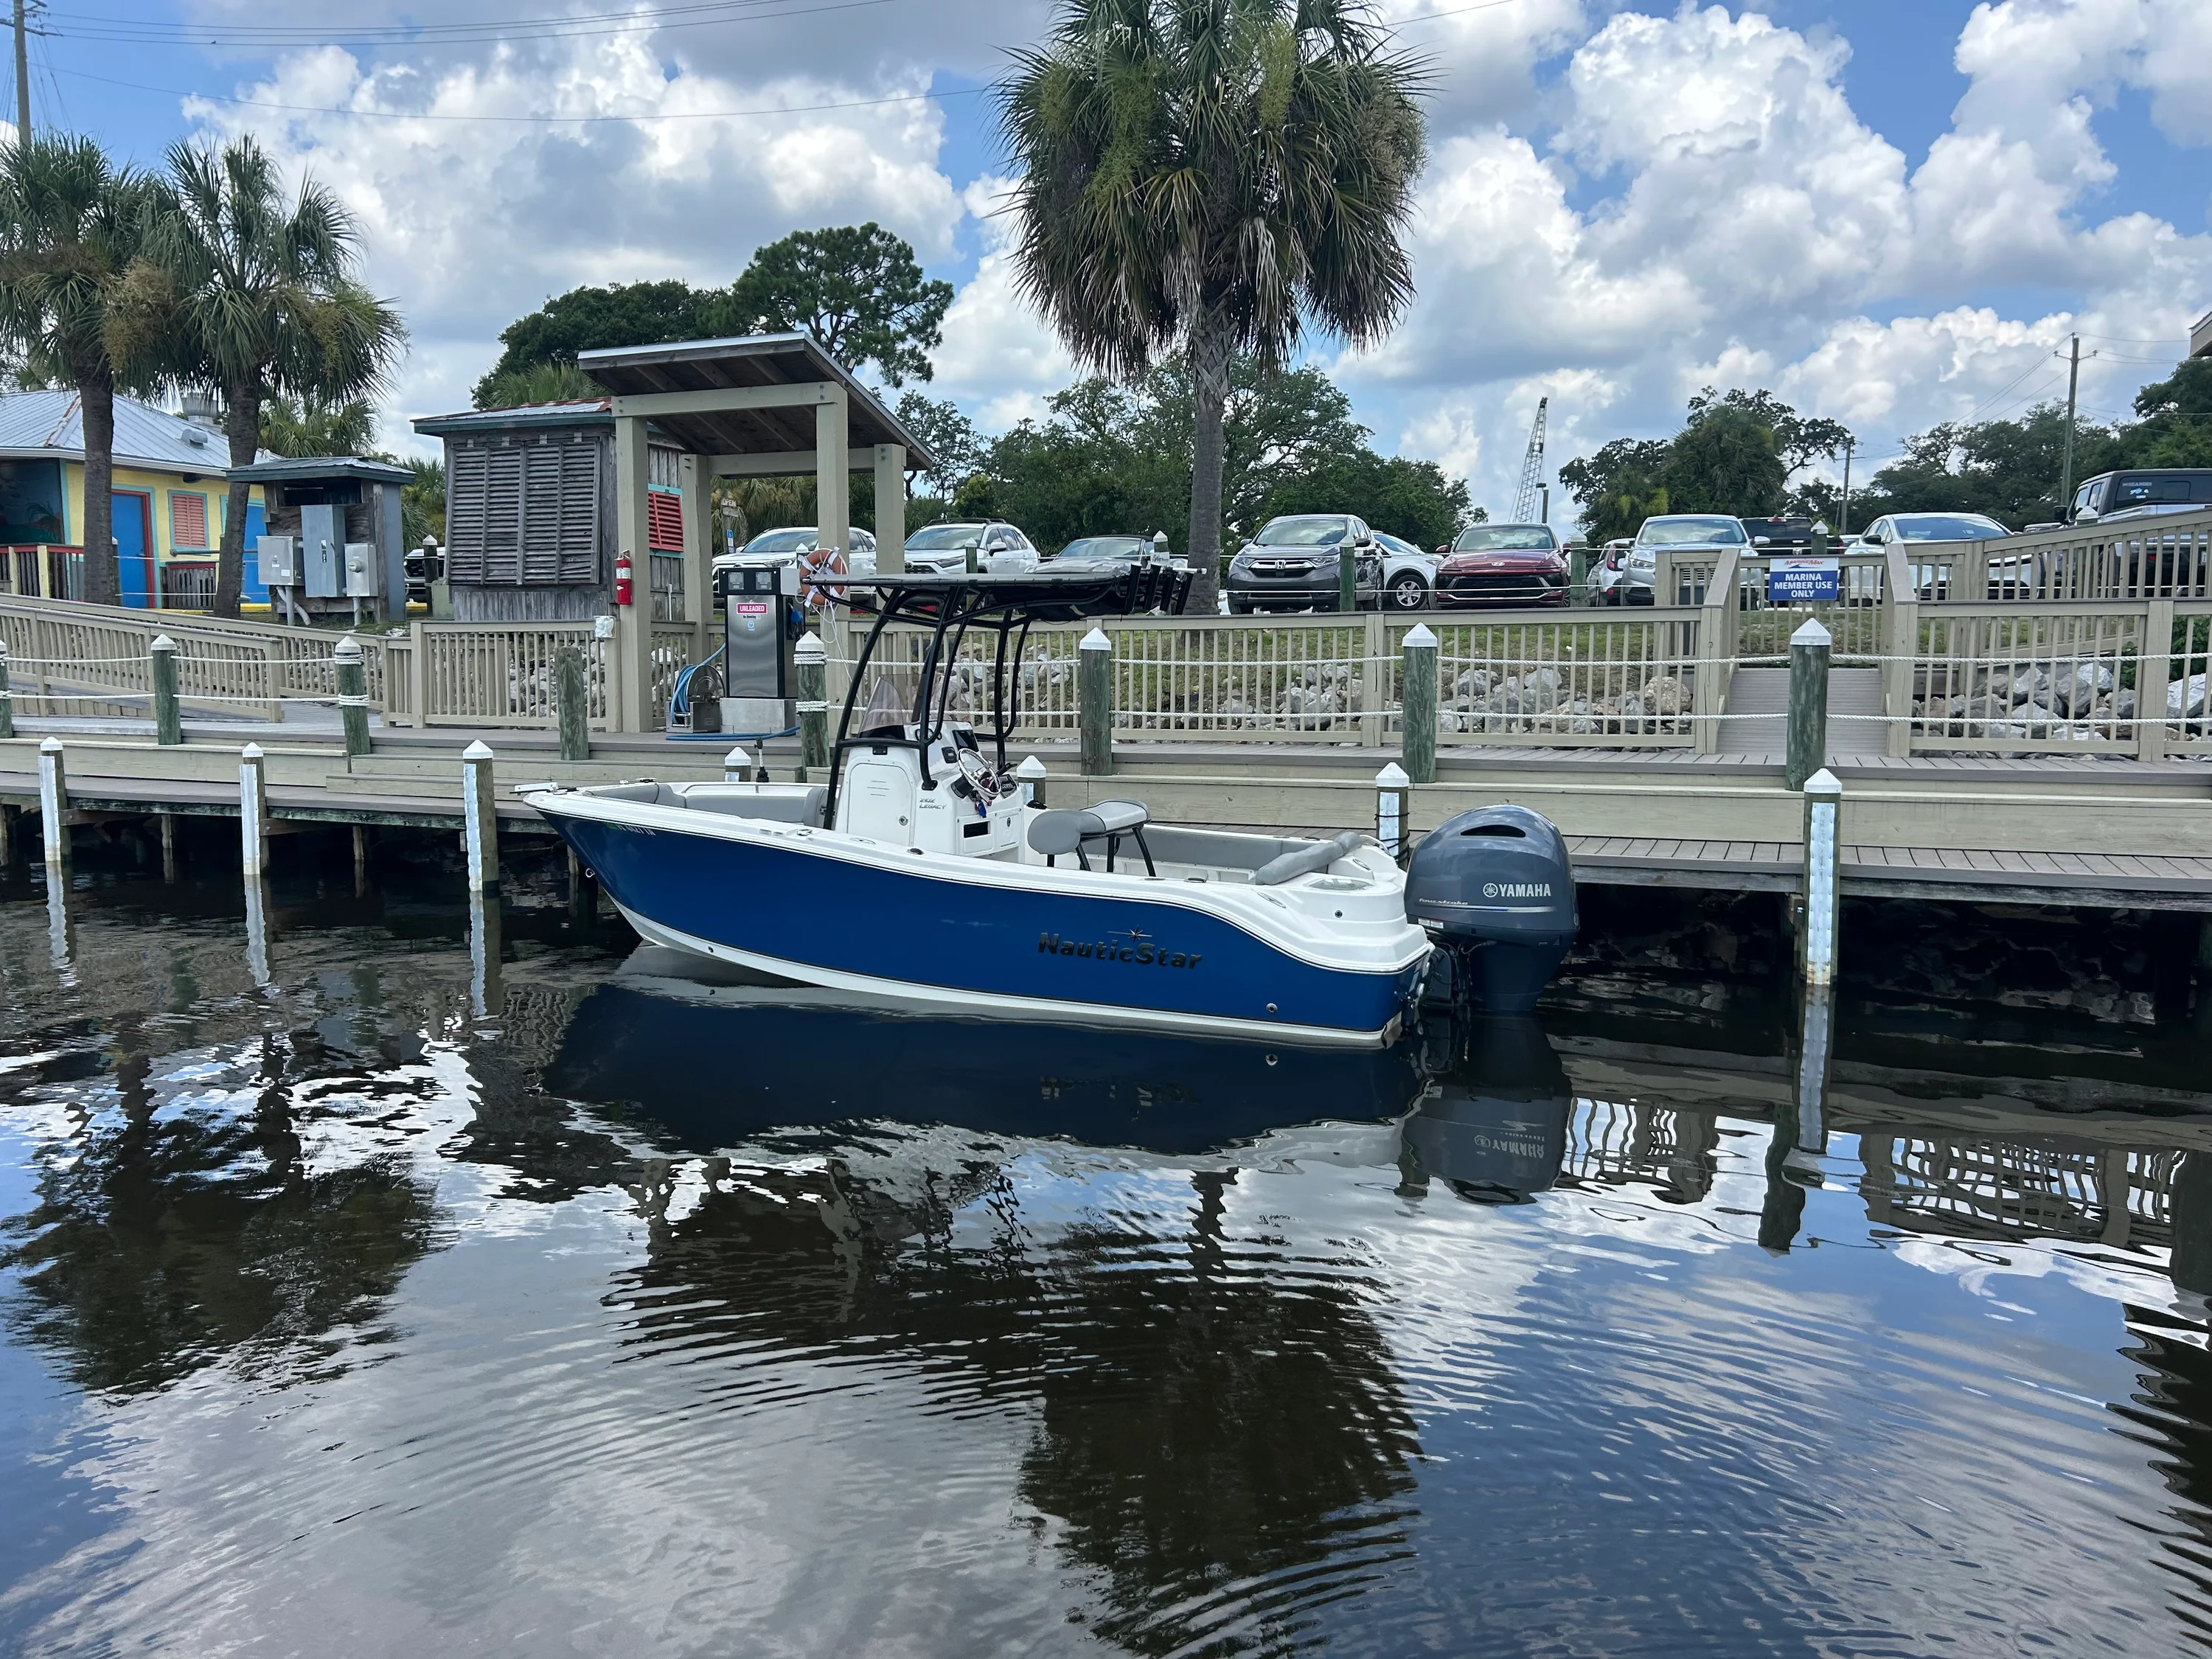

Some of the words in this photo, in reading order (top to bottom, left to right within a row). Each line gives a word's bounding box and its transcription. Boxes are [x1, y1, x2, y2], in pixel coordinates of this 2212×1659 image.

[721, 498, 737, 507] OPEN
[1785, 573, 1822, 581] MARINA
[1815, 581, 1832, 589] USE
[1498, 883, 1551, 897] YAMAHA
[1038, 932, 1203, 968] NauticStar
